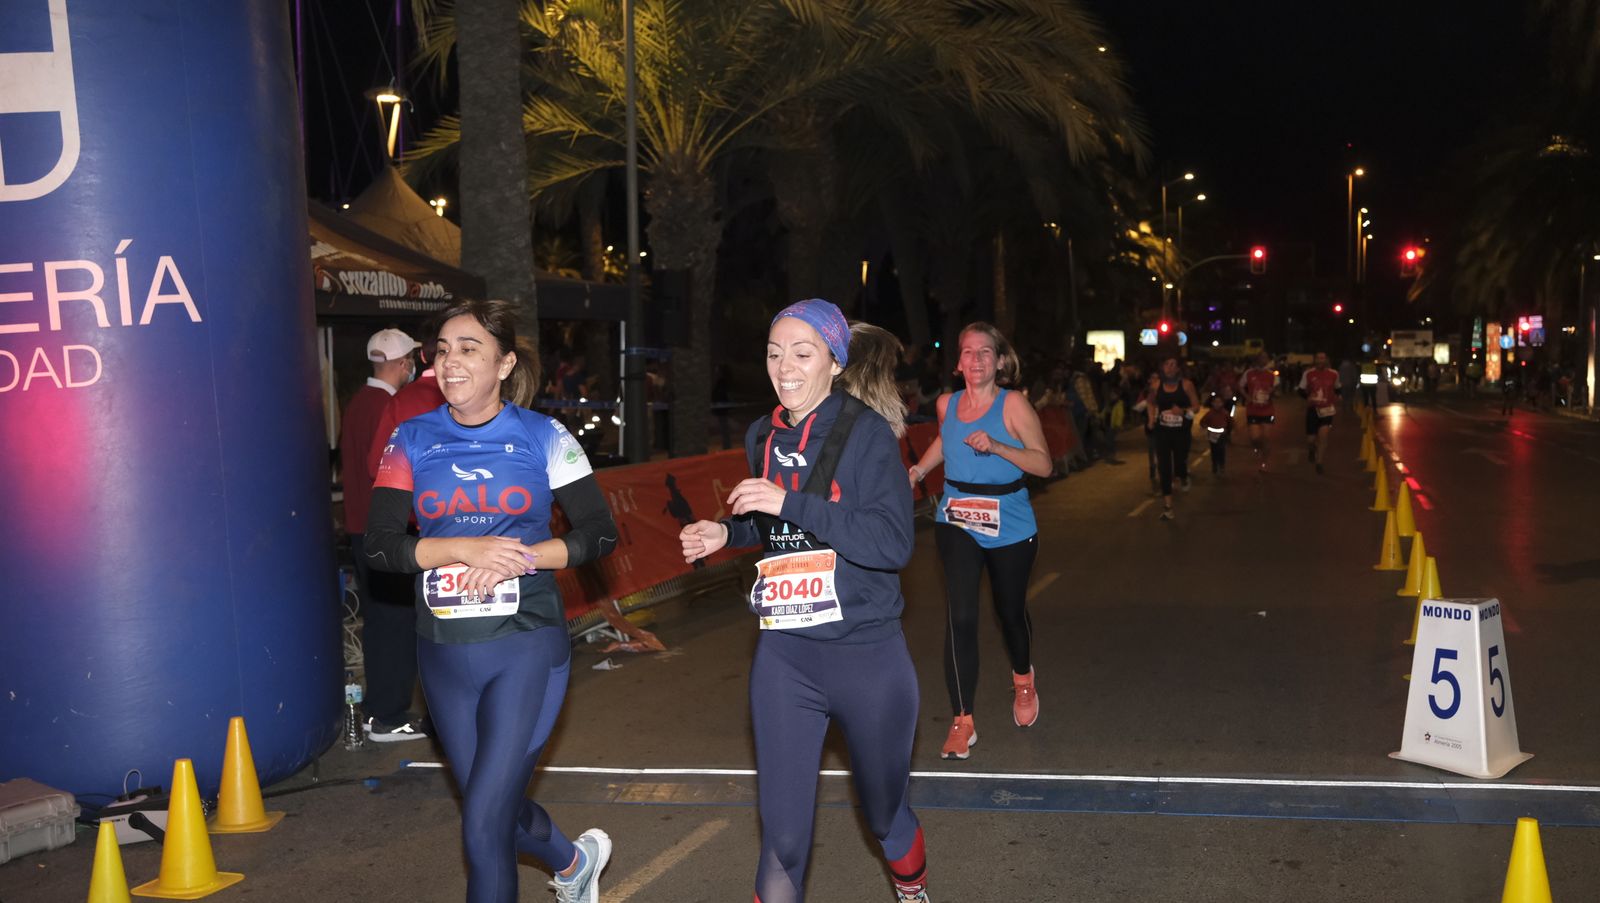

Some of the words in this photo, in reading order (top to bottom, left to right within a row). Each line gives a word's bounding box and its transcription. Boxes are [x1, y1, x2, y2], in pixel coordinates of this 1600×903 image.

[417, 484, 532, 519] GALO
[455, 516, 495, 524] SPORT
[769, 533, 805, 542] RUNITUDE
[765, 577, 823, 602] 3040
[1423, 605, 1471, 621] MONDO
[1479, 603, 1500, 622] MONDO
[1428, 647, 1461, 720] 5
[1488, 644, 1505, 718] 5
